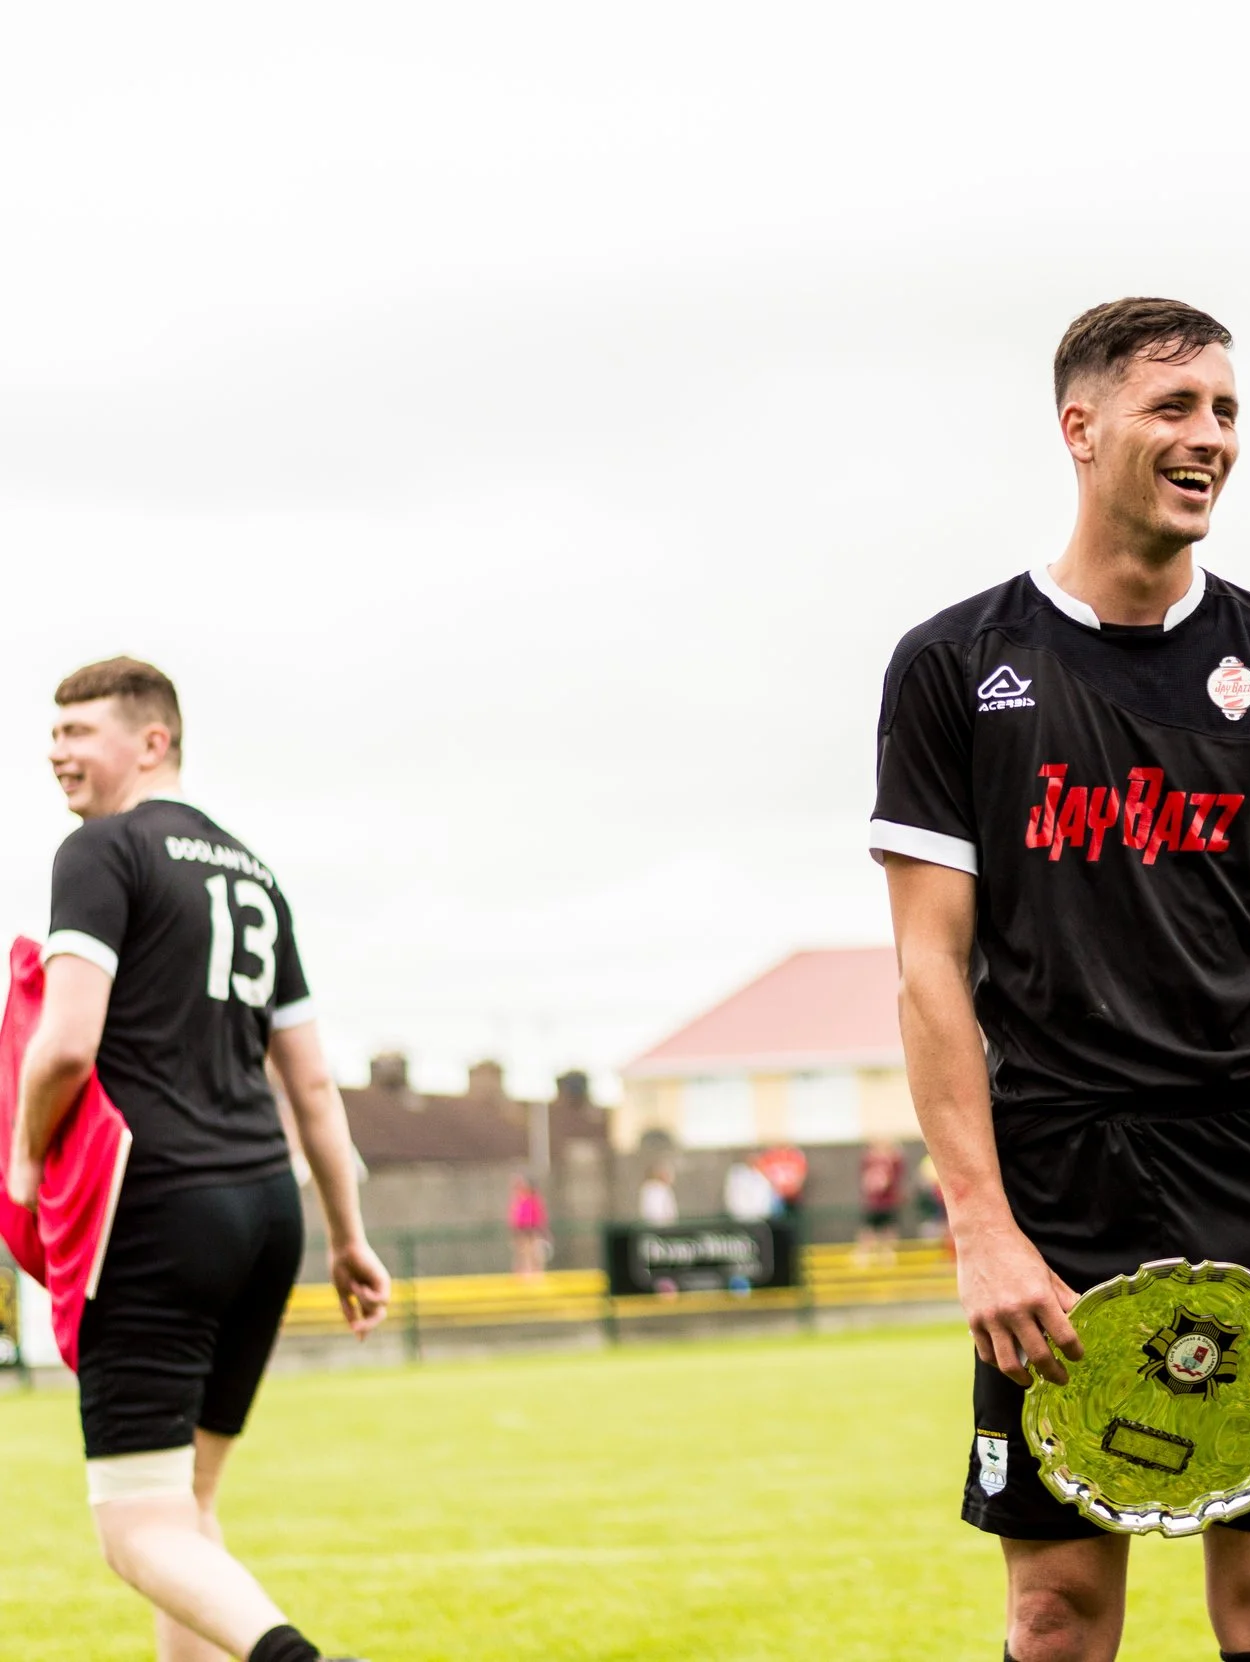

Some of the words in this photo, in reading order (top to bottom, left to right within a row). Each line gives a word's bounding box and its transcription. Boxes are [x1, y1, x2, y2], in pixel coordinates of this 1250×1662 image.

[979, 697, 1036, 712] ACERBIS
[1025, 764, 1120, 861] JAY
[1122, 767, 1245, 865] BAZZ
[204, 874, 279, 1007] 13
